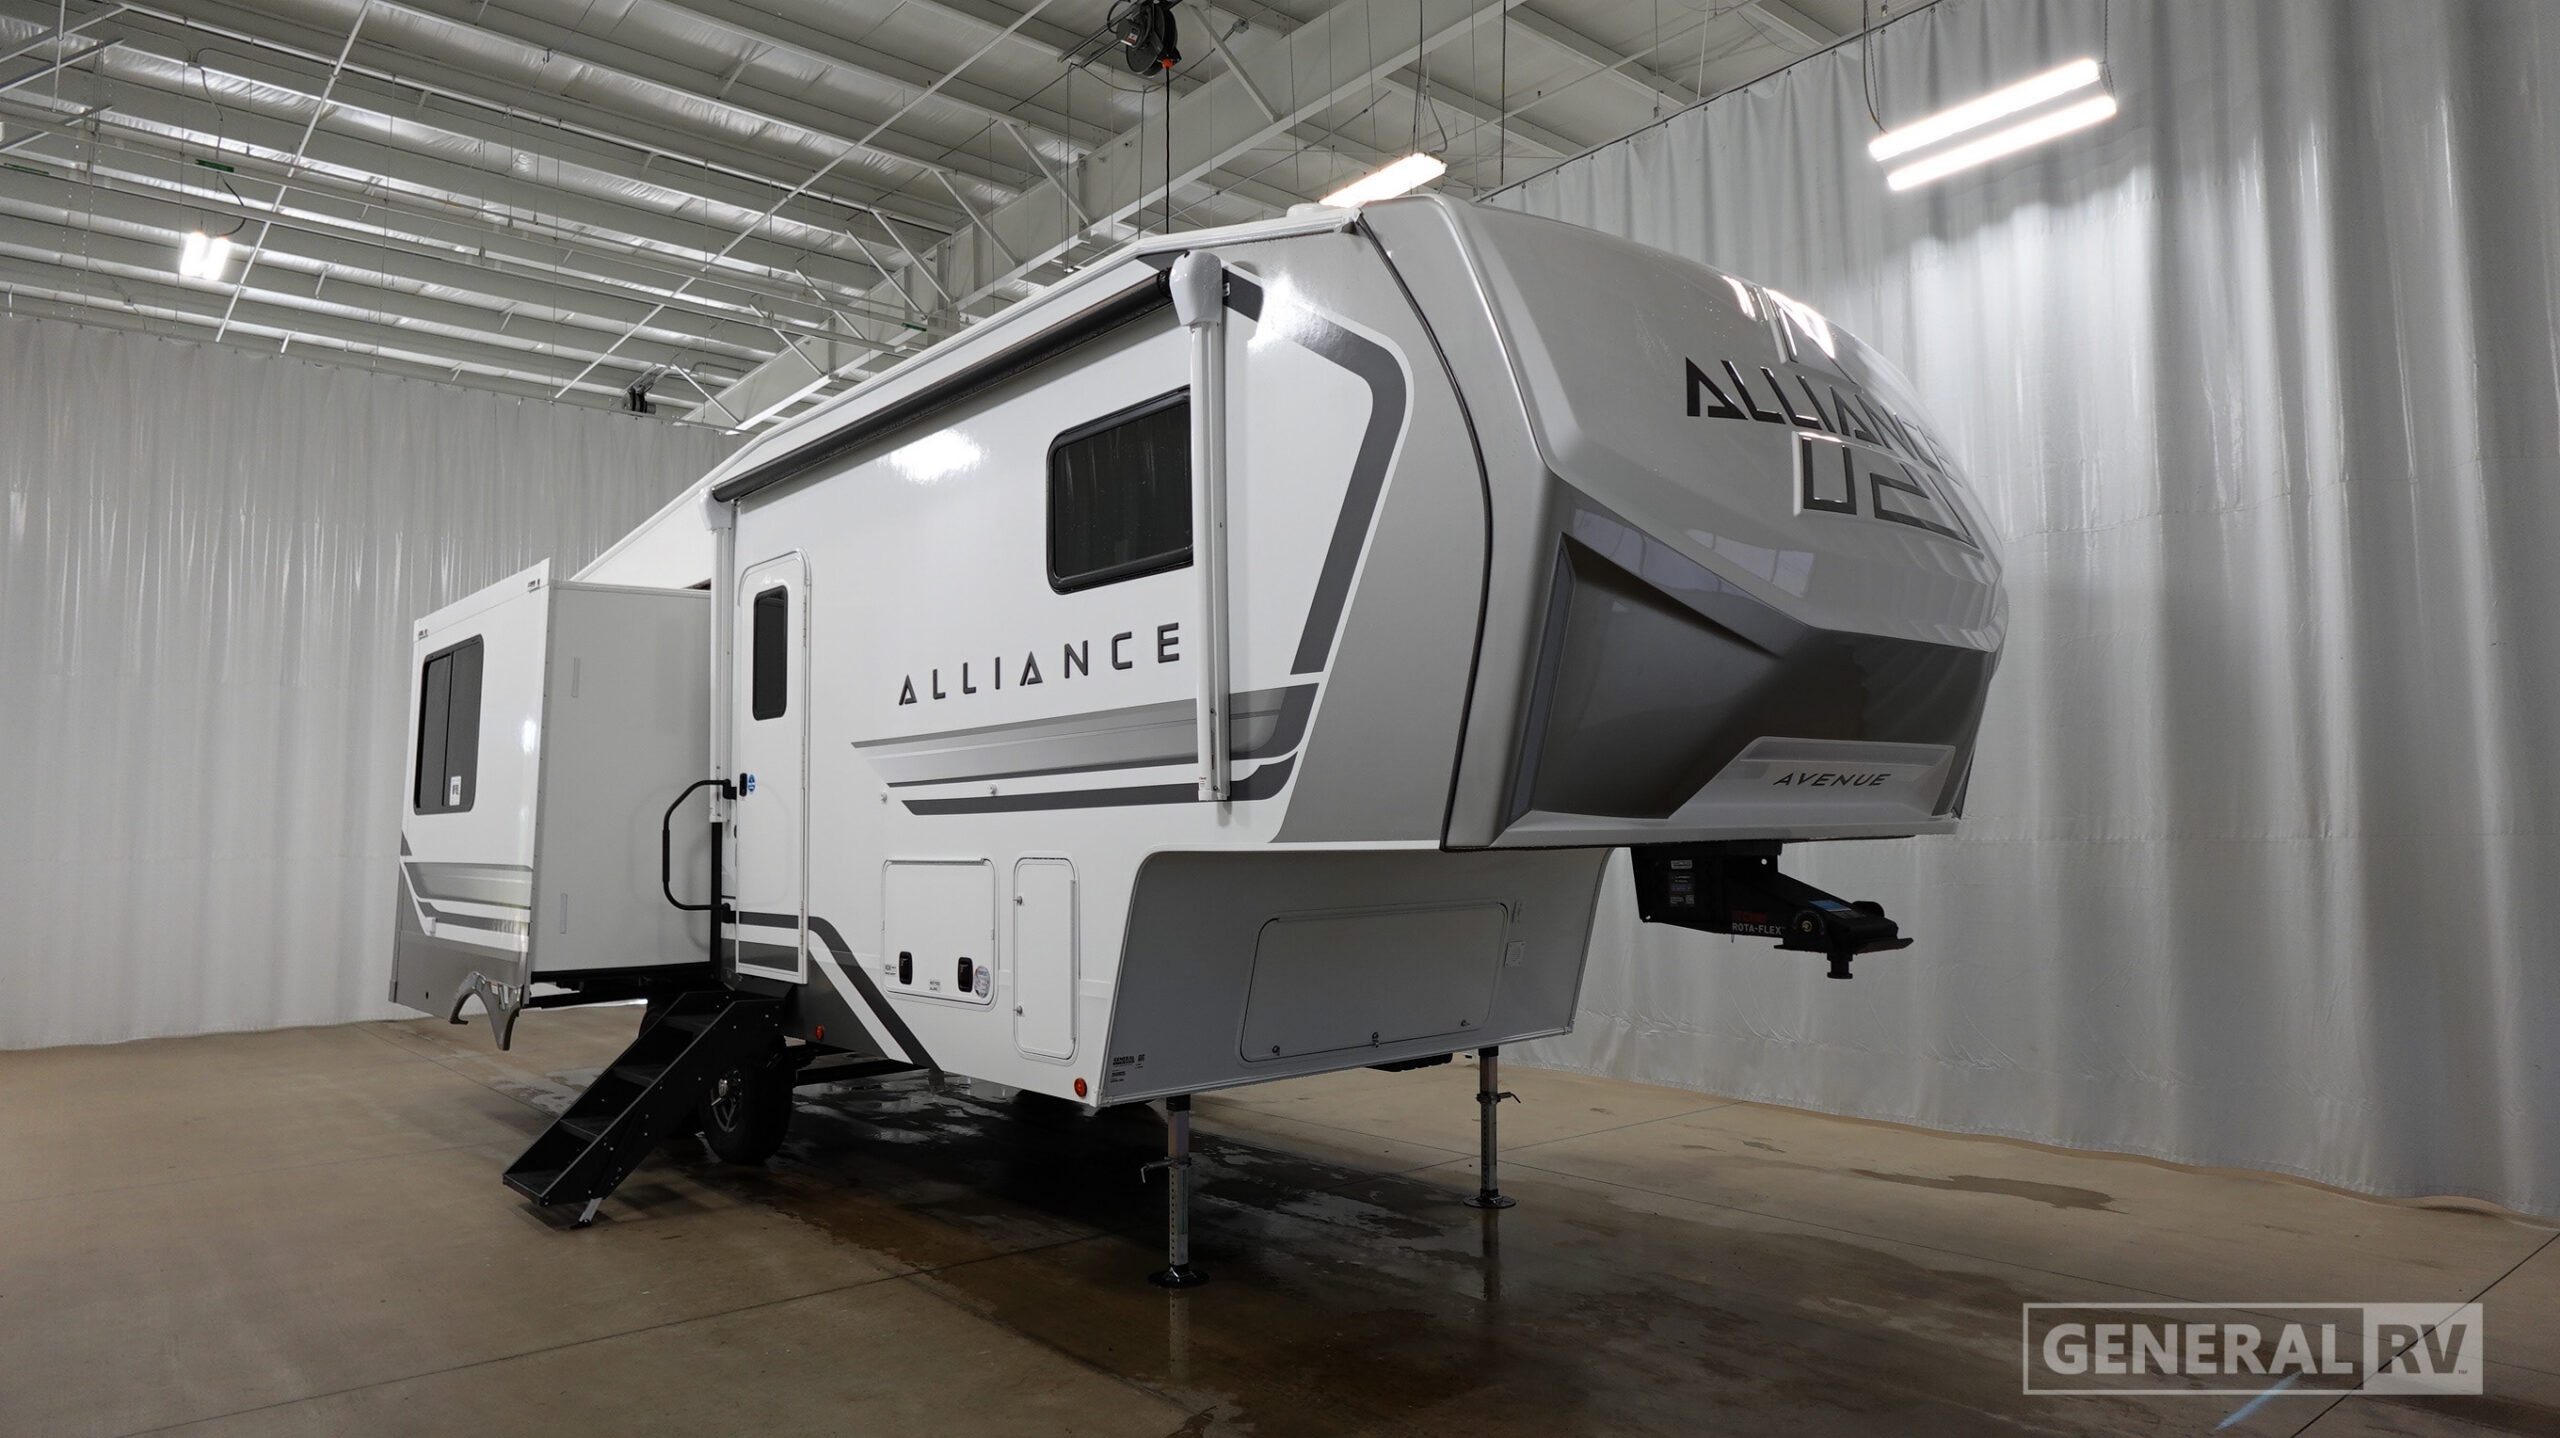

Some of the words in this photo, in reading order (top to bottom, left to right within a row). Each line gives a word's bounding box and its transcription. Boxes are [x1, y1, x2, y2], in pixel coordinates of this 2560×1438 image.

[898, 622, 1180, 706] ALLIANCE
[1773, 772, 1892, 787] AVENUE
[1731, 922, 1782, 936] ROTA-FLEX
